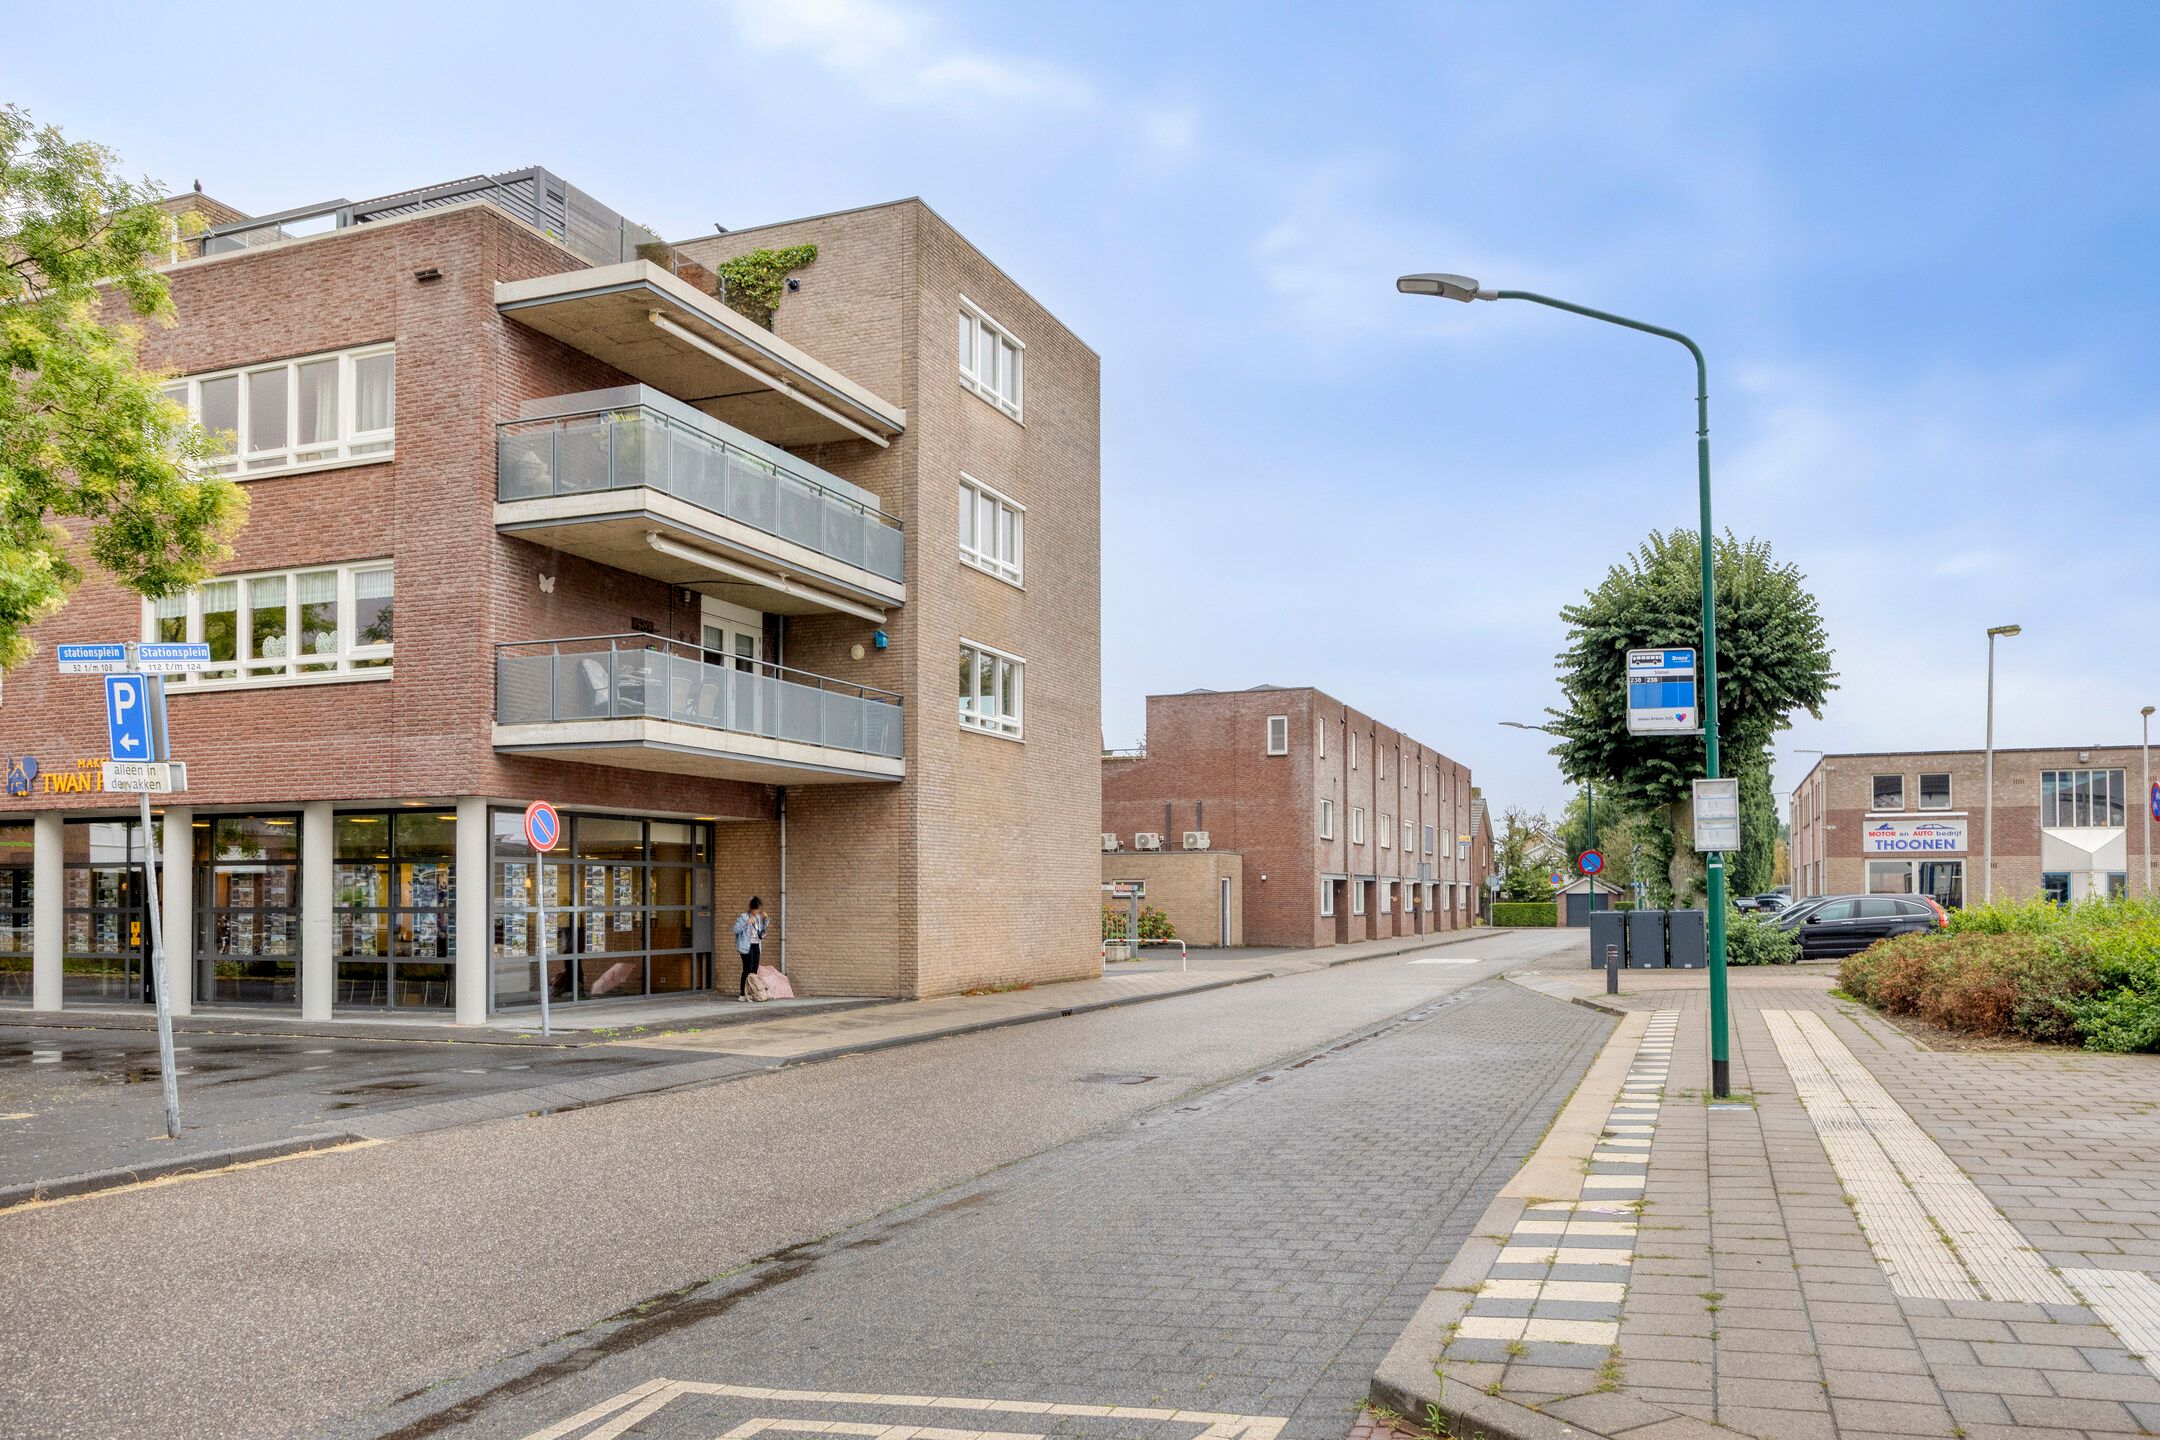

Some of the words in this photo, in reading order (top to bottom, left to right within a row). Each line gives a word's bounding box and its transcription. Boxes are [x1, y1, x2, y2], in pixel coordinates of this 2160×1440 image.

[63, 646, 120, 660] stationsplein
[141, 646, 208, 660] Stationsplein
[73, 664, 82, 672] 52
[85, 664, 100, 672] t/m
[148, 663, 163, 671] 112
[165, 662, 184, 671] t/m
[186, 663, 202, 671] 124
[113, 682, 136, 725] P
[114, 764, 144, 776] alleen
[146, 764, 156, 776] in
[42, 770, 92, 793] TWAN
[111, 777, 123, 789] de
[127, 778, 162, 791] vakken
[1874, 839, 1956, 850] THOONEN
